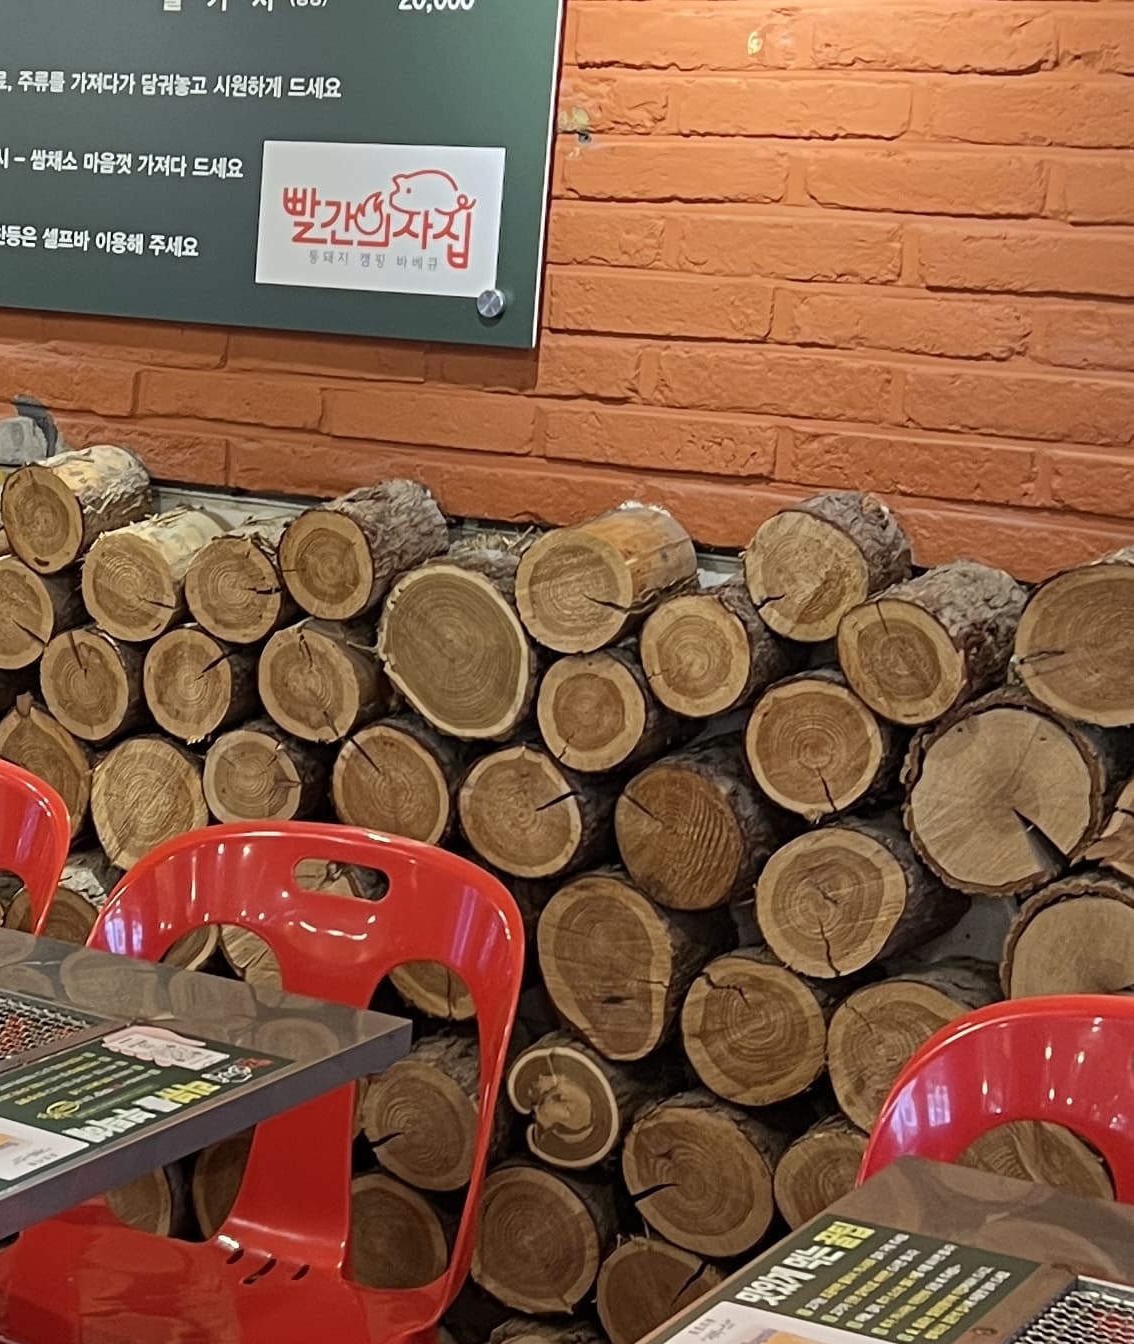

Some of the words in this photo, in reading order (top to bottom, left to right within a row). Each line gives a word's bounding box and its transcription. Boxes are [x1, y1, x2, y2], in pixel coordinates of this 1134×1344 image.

[213, 74, 283, 98] 시원하게
[287, 76, 342, 99] 드세요
[192, 157, 244, 180] 드세요
[42, 227, 91, 251] 셀프바
[95, 231, 144, 255] 이용해
[148, 234, 199, 257] 주세요
[814, 1220, 876, 1250] 꿀팁
[783, 1245, 846, 1270] 먹는
[734, 1265, 817, 1307] 맛있게
